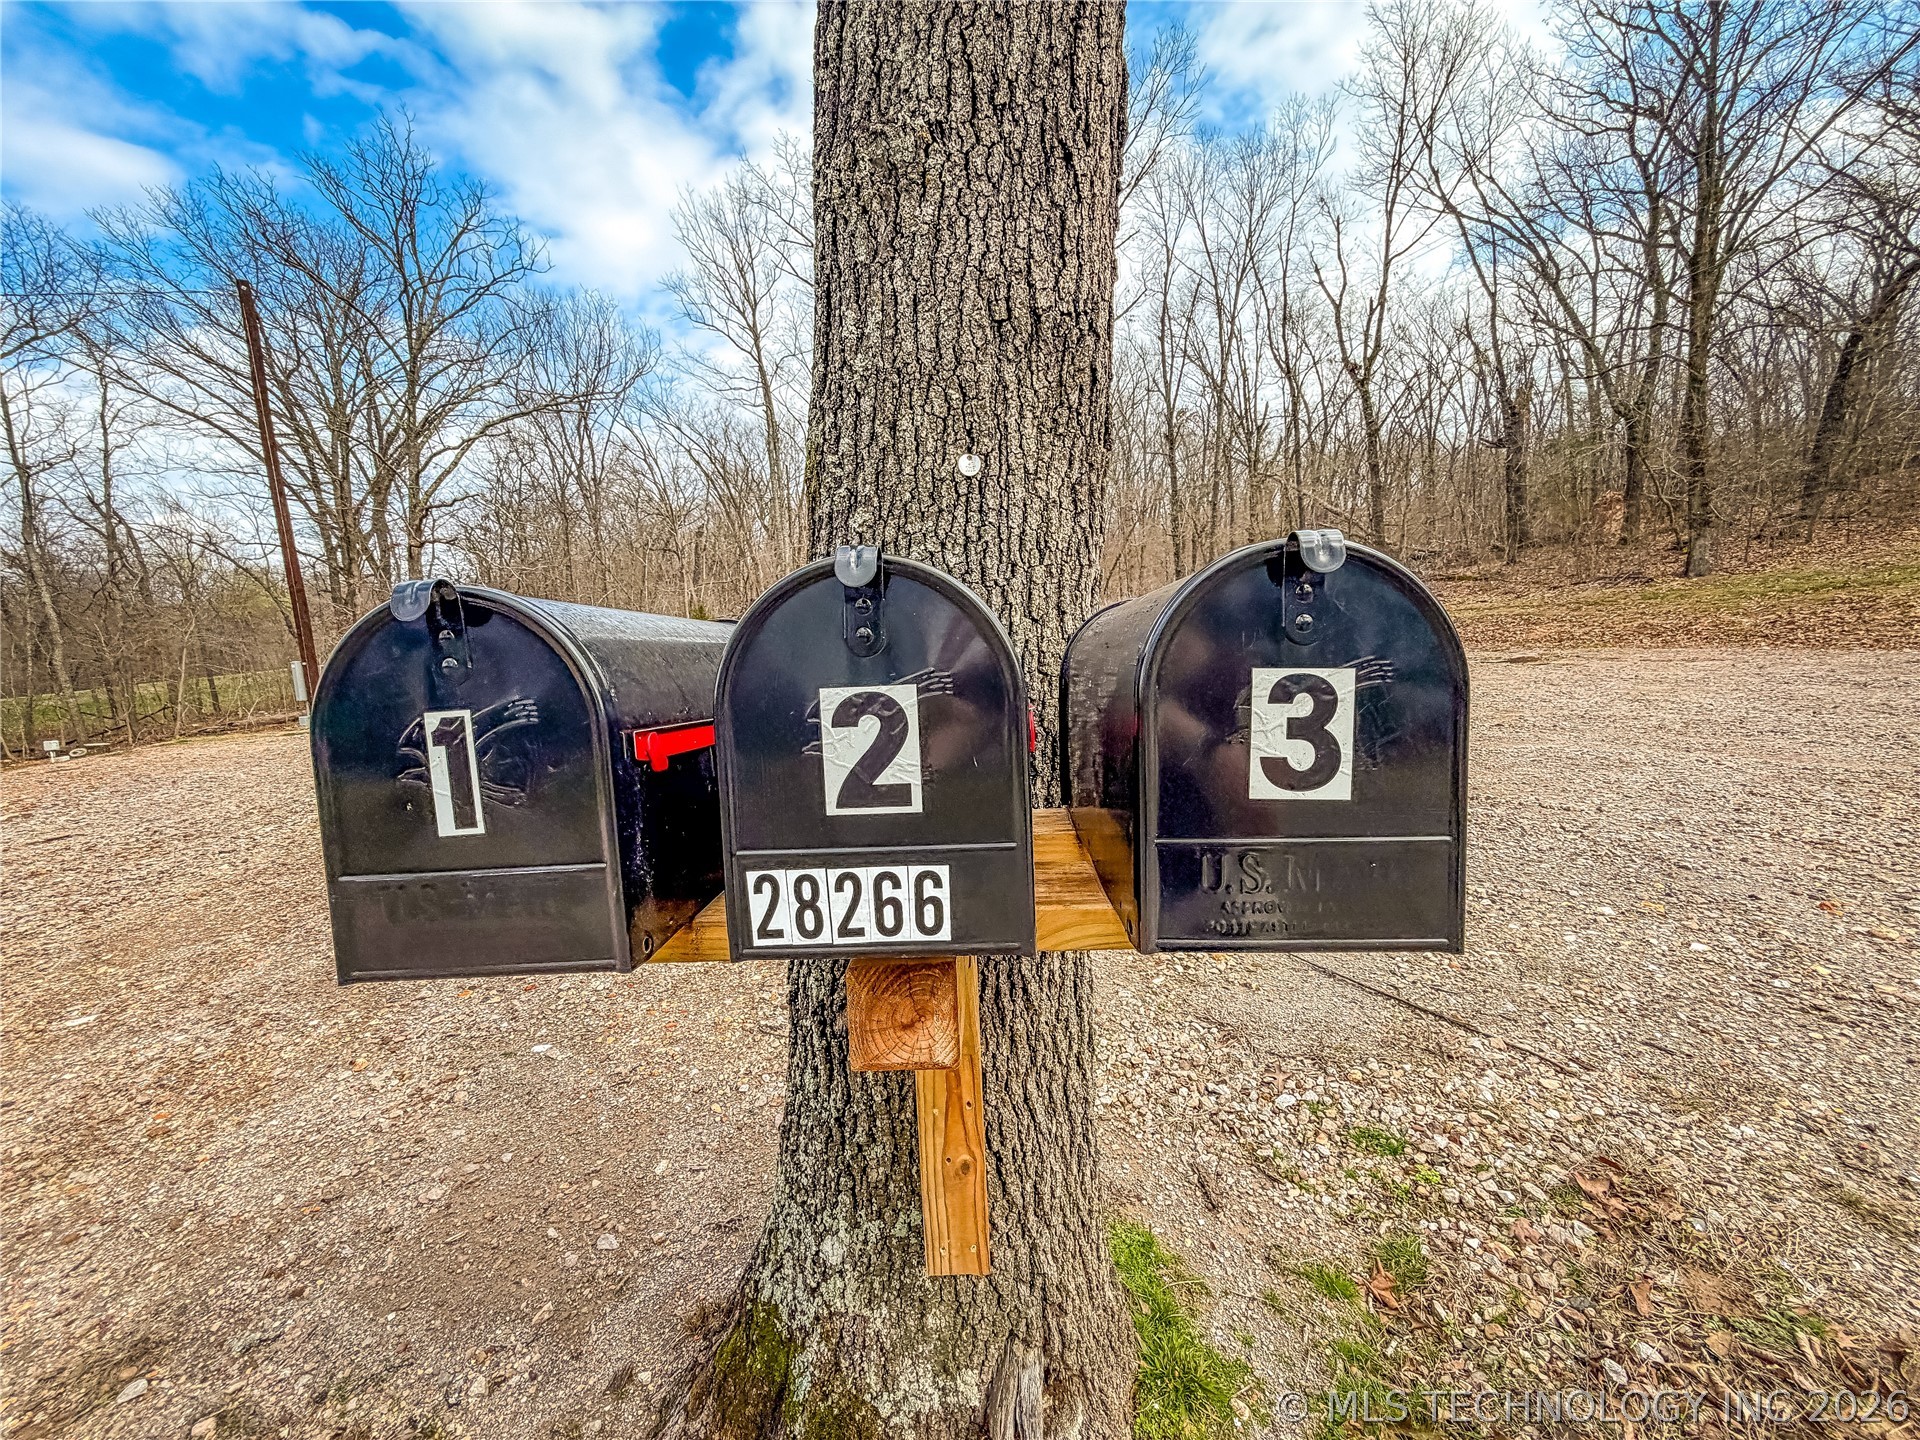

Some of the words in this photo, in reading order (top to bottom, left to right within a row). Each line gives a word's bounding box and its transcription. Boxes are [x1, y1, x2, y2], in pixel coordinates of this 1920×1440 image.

[430, 714, 479, 830] 1
[831, 690, 913, 809] 2
[1259, 672, 1342, 793] 3
[752, 869, 945, 940] 28266
